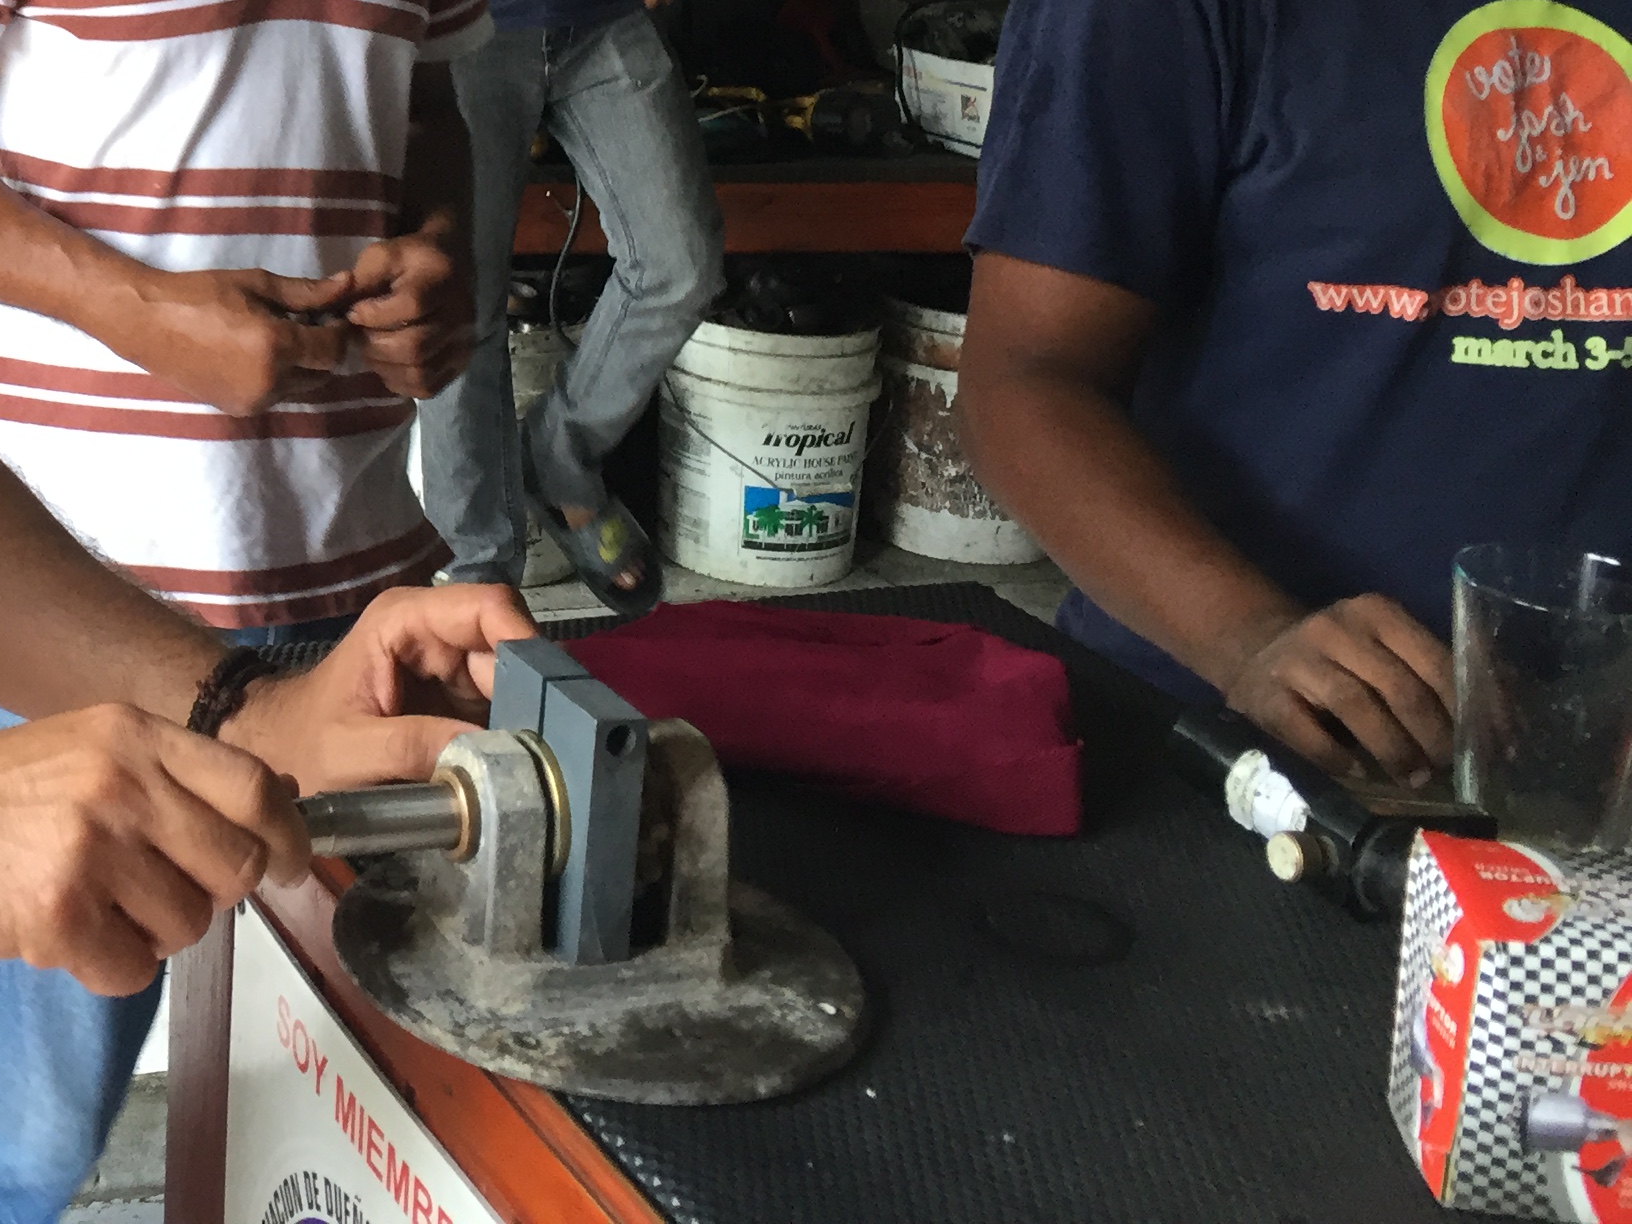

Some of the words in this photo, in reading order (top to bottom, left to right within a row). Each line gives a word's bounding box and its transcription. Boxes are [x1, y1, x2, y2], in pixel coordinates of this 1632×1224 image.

[1465, 35, 1552, 100] vote
[1497, 93, 1592, 173] josh
[1538, 148, 1614, 220] jen
[1451, 330, 1579, 370] march
[752, 455, 801, 469] ACRYLIC
[276, 994, 329, 1097] SOY
[303, 1170, 322, 1212] DE
